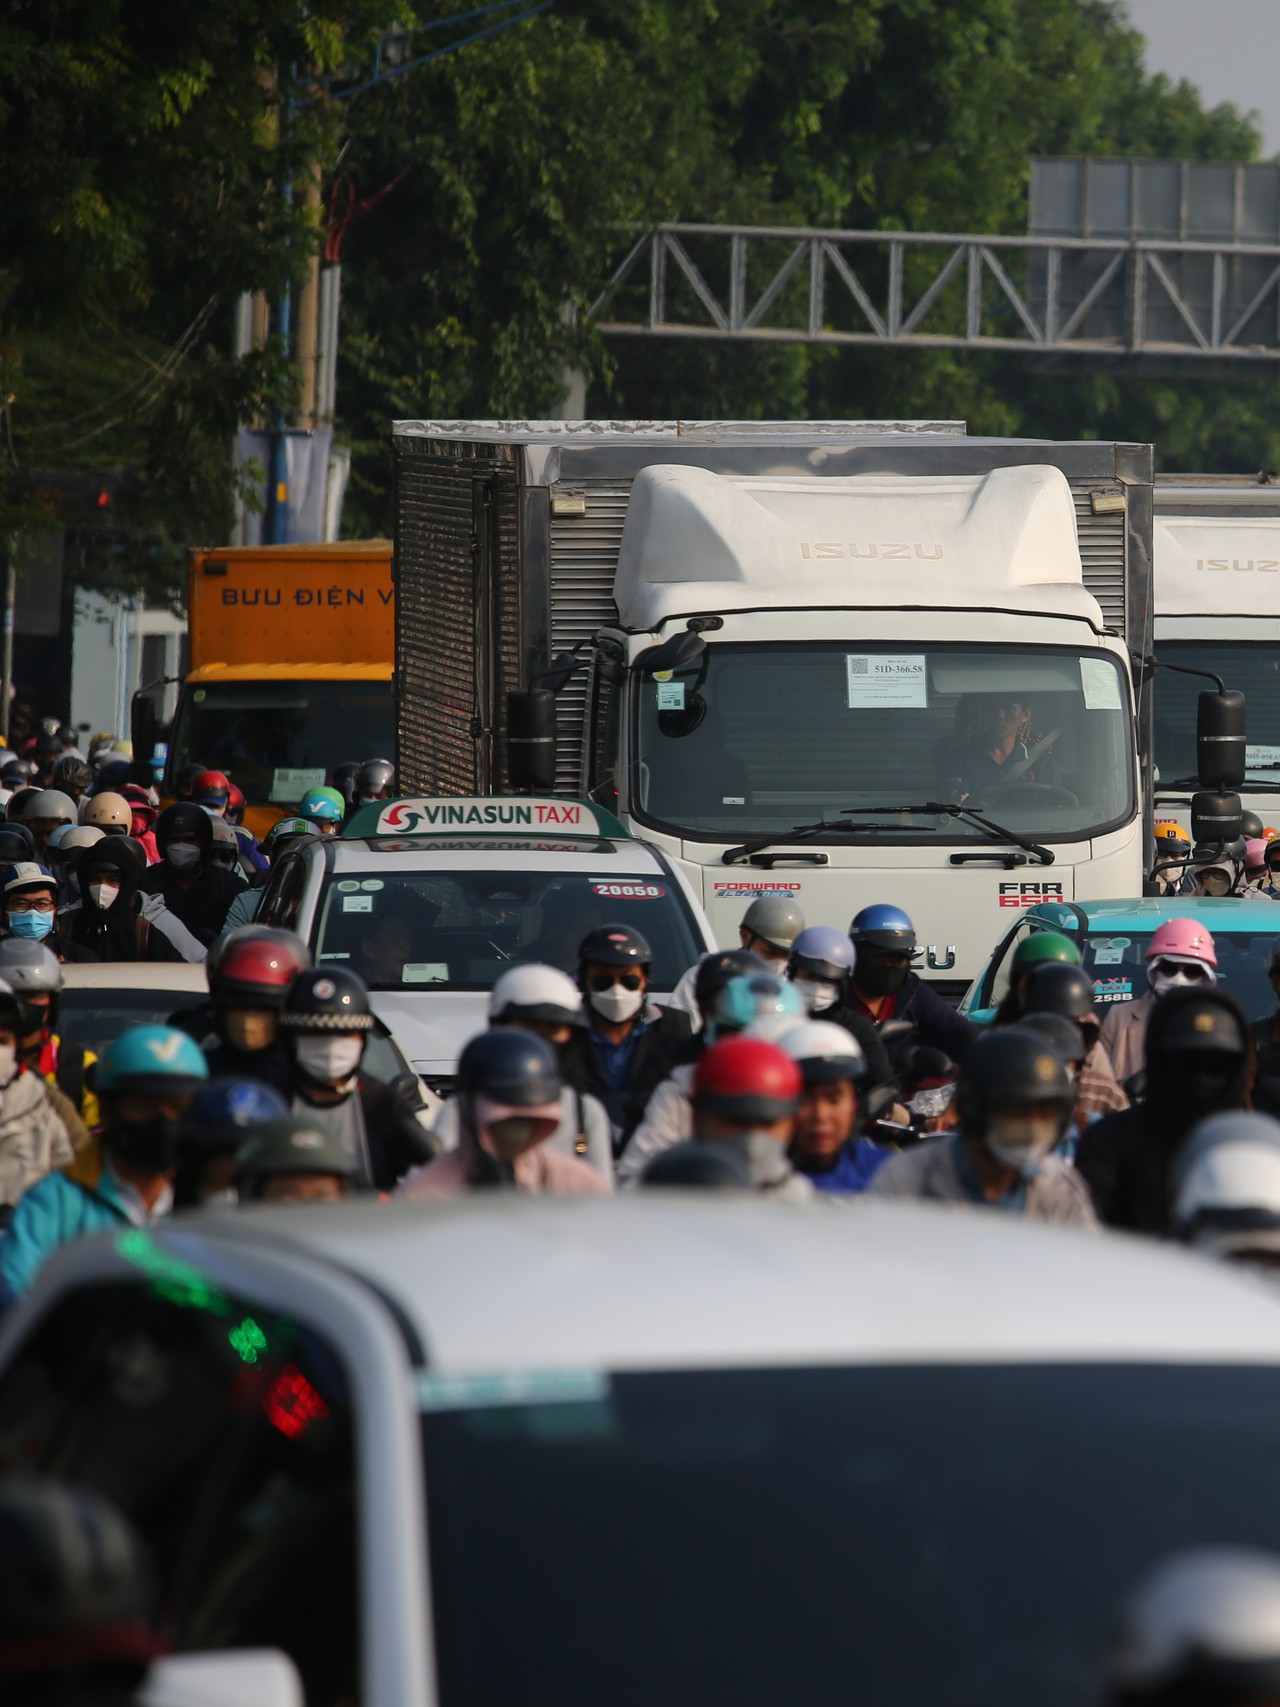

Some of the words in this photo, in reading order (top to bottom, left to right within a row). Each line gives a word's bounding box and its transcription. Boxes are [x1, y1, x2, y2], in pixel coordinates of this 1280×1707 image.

[800, 542, 944, 560] ISUZU
[222, 588, 281, 606] BƯU
[294, 584, 364, 609] ĐIỆN
[874, 665, 923, 674] 51D-366.58
[424, 805, 532, 824] VINASUN
[534, 806, 580, 824] TAXI
[596, 885, 659, 897] 20050
[714, 882, 801, 891] FORWARD
[999, 882, 1063, 895] FRR
[908, 944, 956, 970] ZU
[1093, 993, 1133, 1003] 258B
